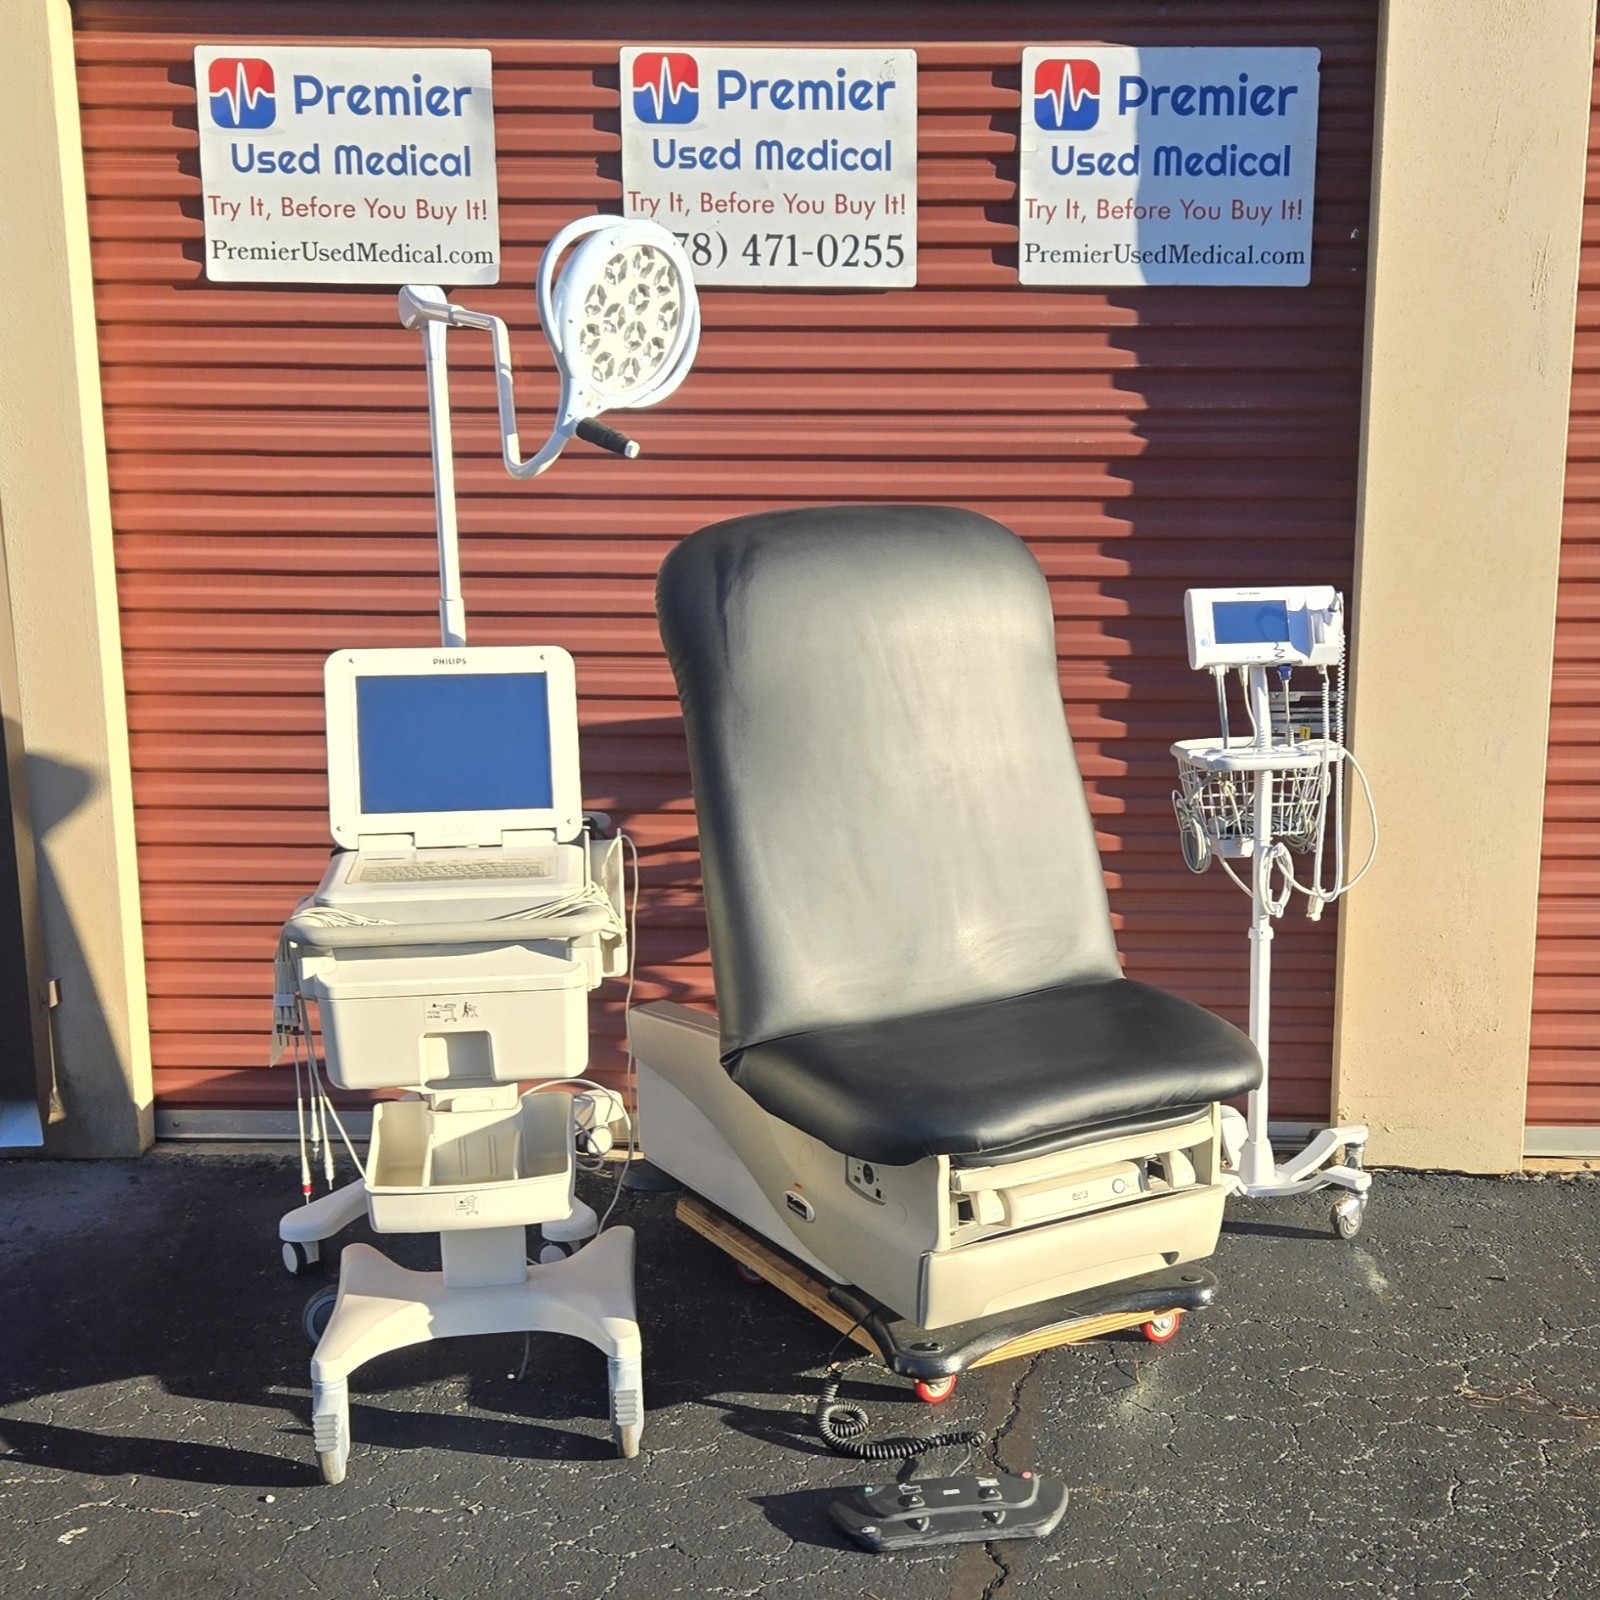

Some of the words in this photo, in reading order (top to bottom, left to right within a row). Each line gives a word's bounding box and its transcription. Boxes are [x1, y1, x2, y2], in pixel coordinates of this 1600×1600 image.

[293, 74, 472, 116] Premier
[718, 67, 895, 110] Premier
[1118, 72, 1298, 116] Premier
[231, 143, 320, 174] Used
[335, 144, 471, 176] Medical
[653, 138, 741, 170] Used
[755, 138, 892, 171] Medical
[1052, 144, 1139, 176] Used
[1153, 144, 1291, 176] Medical
[208, 195, 241, 221] Try
[250, 196, 272, 220] It,
[281, 196, 356, 218] Before
[364, 197, 406, 219] You
[416, 199, 457, 225] Buy
[466, 199, 487, 220] It!
[628, 191, 661, 216] Try
[669, 192, 690, 216] It,
[700, 191, 775, 214] Before
[783, 193, 825, 214] You
[835, 194, 875, 220] Buy
[885, 194, 905, 215] It!
[1025, 198, 1057, 224] Try
[1066, 199, 1086, 223] It,
[1097, 198, 1171, 220] Before
[1180, 199, 1221, 220] You
[1231, 199, 1273, 225] Buy
[1282, 199, 1302, 220] It!
[211, 239, 494, 264] PremierUsedMedical.com
[672, 231, 728, 269] 78)
[742, 233, 904, 268] 471-0255
[1024, 243, 1305, 265] PremierUsedMedical.com
[432, 657, 467, 665] PHILIPS
